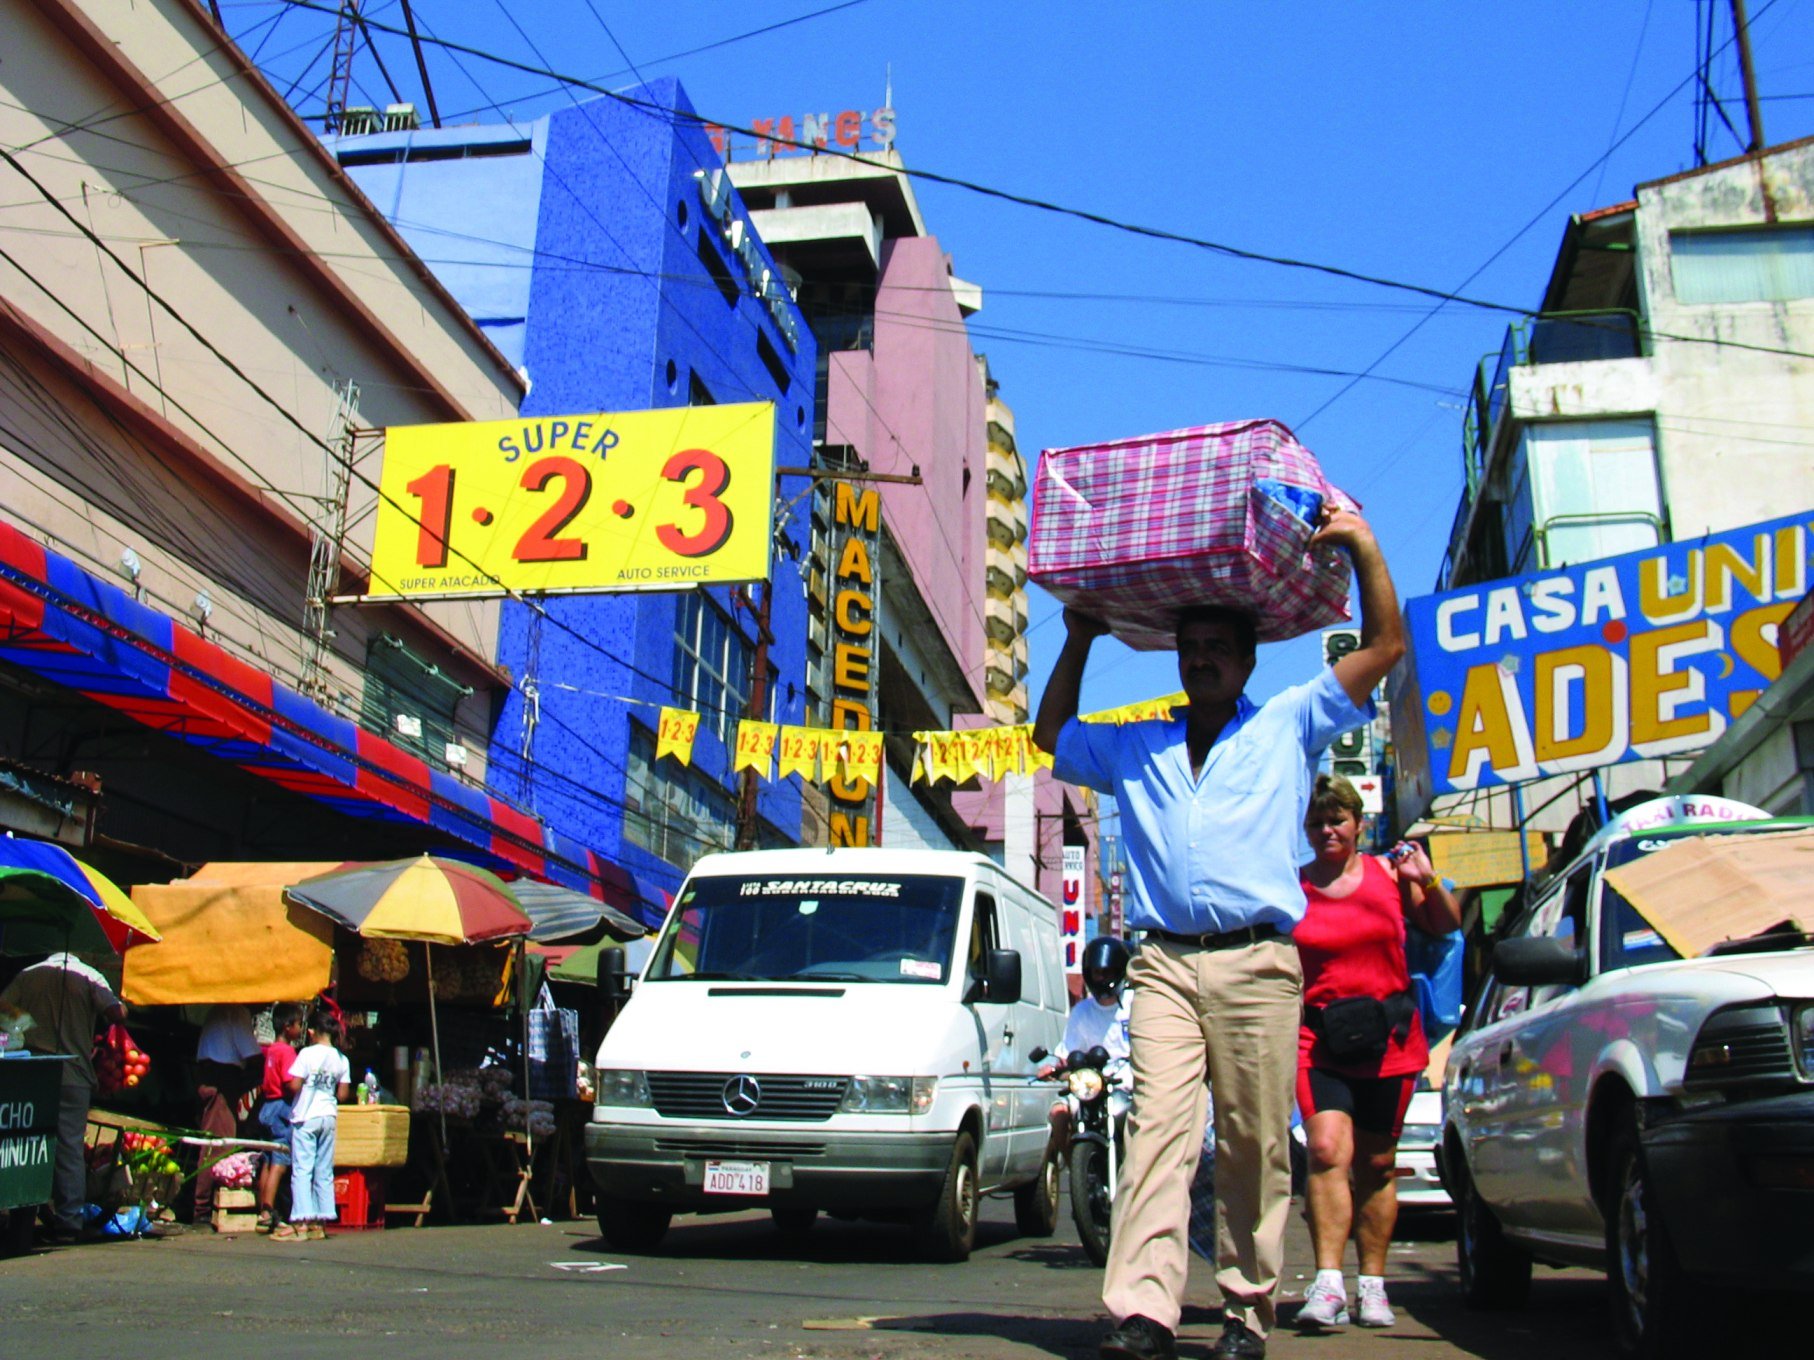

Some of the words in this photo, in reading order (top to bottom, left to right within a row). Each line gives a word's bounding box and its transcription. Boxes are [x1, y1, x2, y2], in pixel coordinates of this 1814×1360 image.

[499, 421, 620, 462] SUPER
[617, 568, 652, 581] AUTO
[656, 565, 710, 578] SERVICE
[400, 577, 437, 590] SUPER
[440, 575, 501, 588] ATACADO
[1436, 565, 1627, 652] CASA
[1639, 523, 1814, 626] UNI
[710, 1173, 734, 1190] ADD
[738, 1174, 763, 1191] 418
